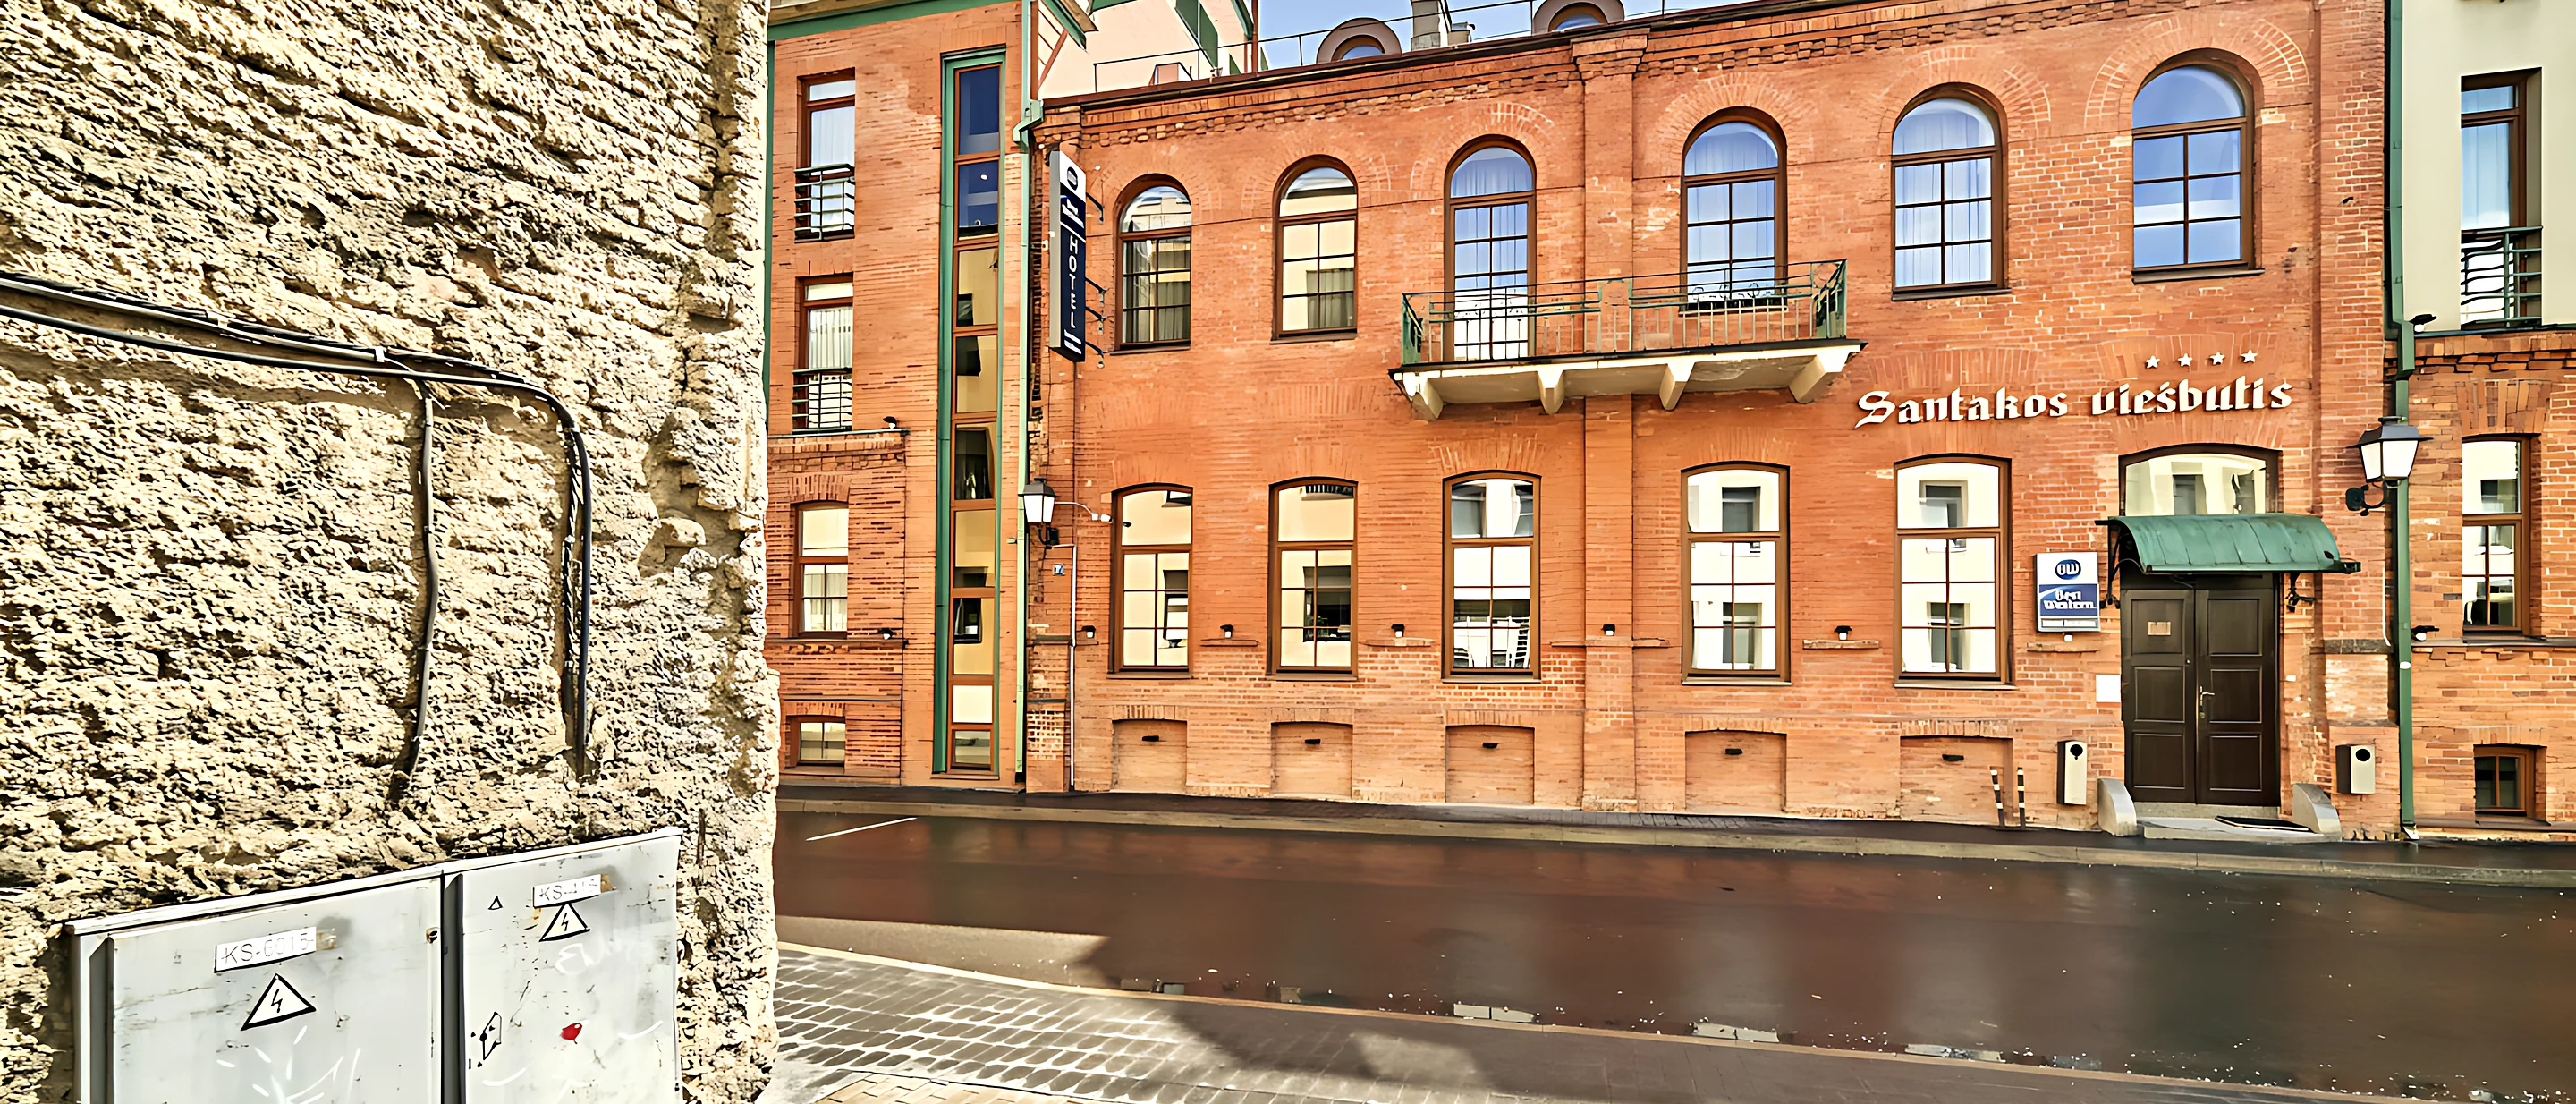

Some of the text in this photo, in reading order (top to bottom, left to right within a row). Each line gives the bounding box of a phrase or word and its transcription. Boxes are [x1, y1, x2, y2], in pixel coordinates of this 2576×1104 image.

[1069, 234, 1079, 328] HOTEL
[1854, 386, 2068, 429] Santakos
[221, 932, 310, 964] KS-6015
